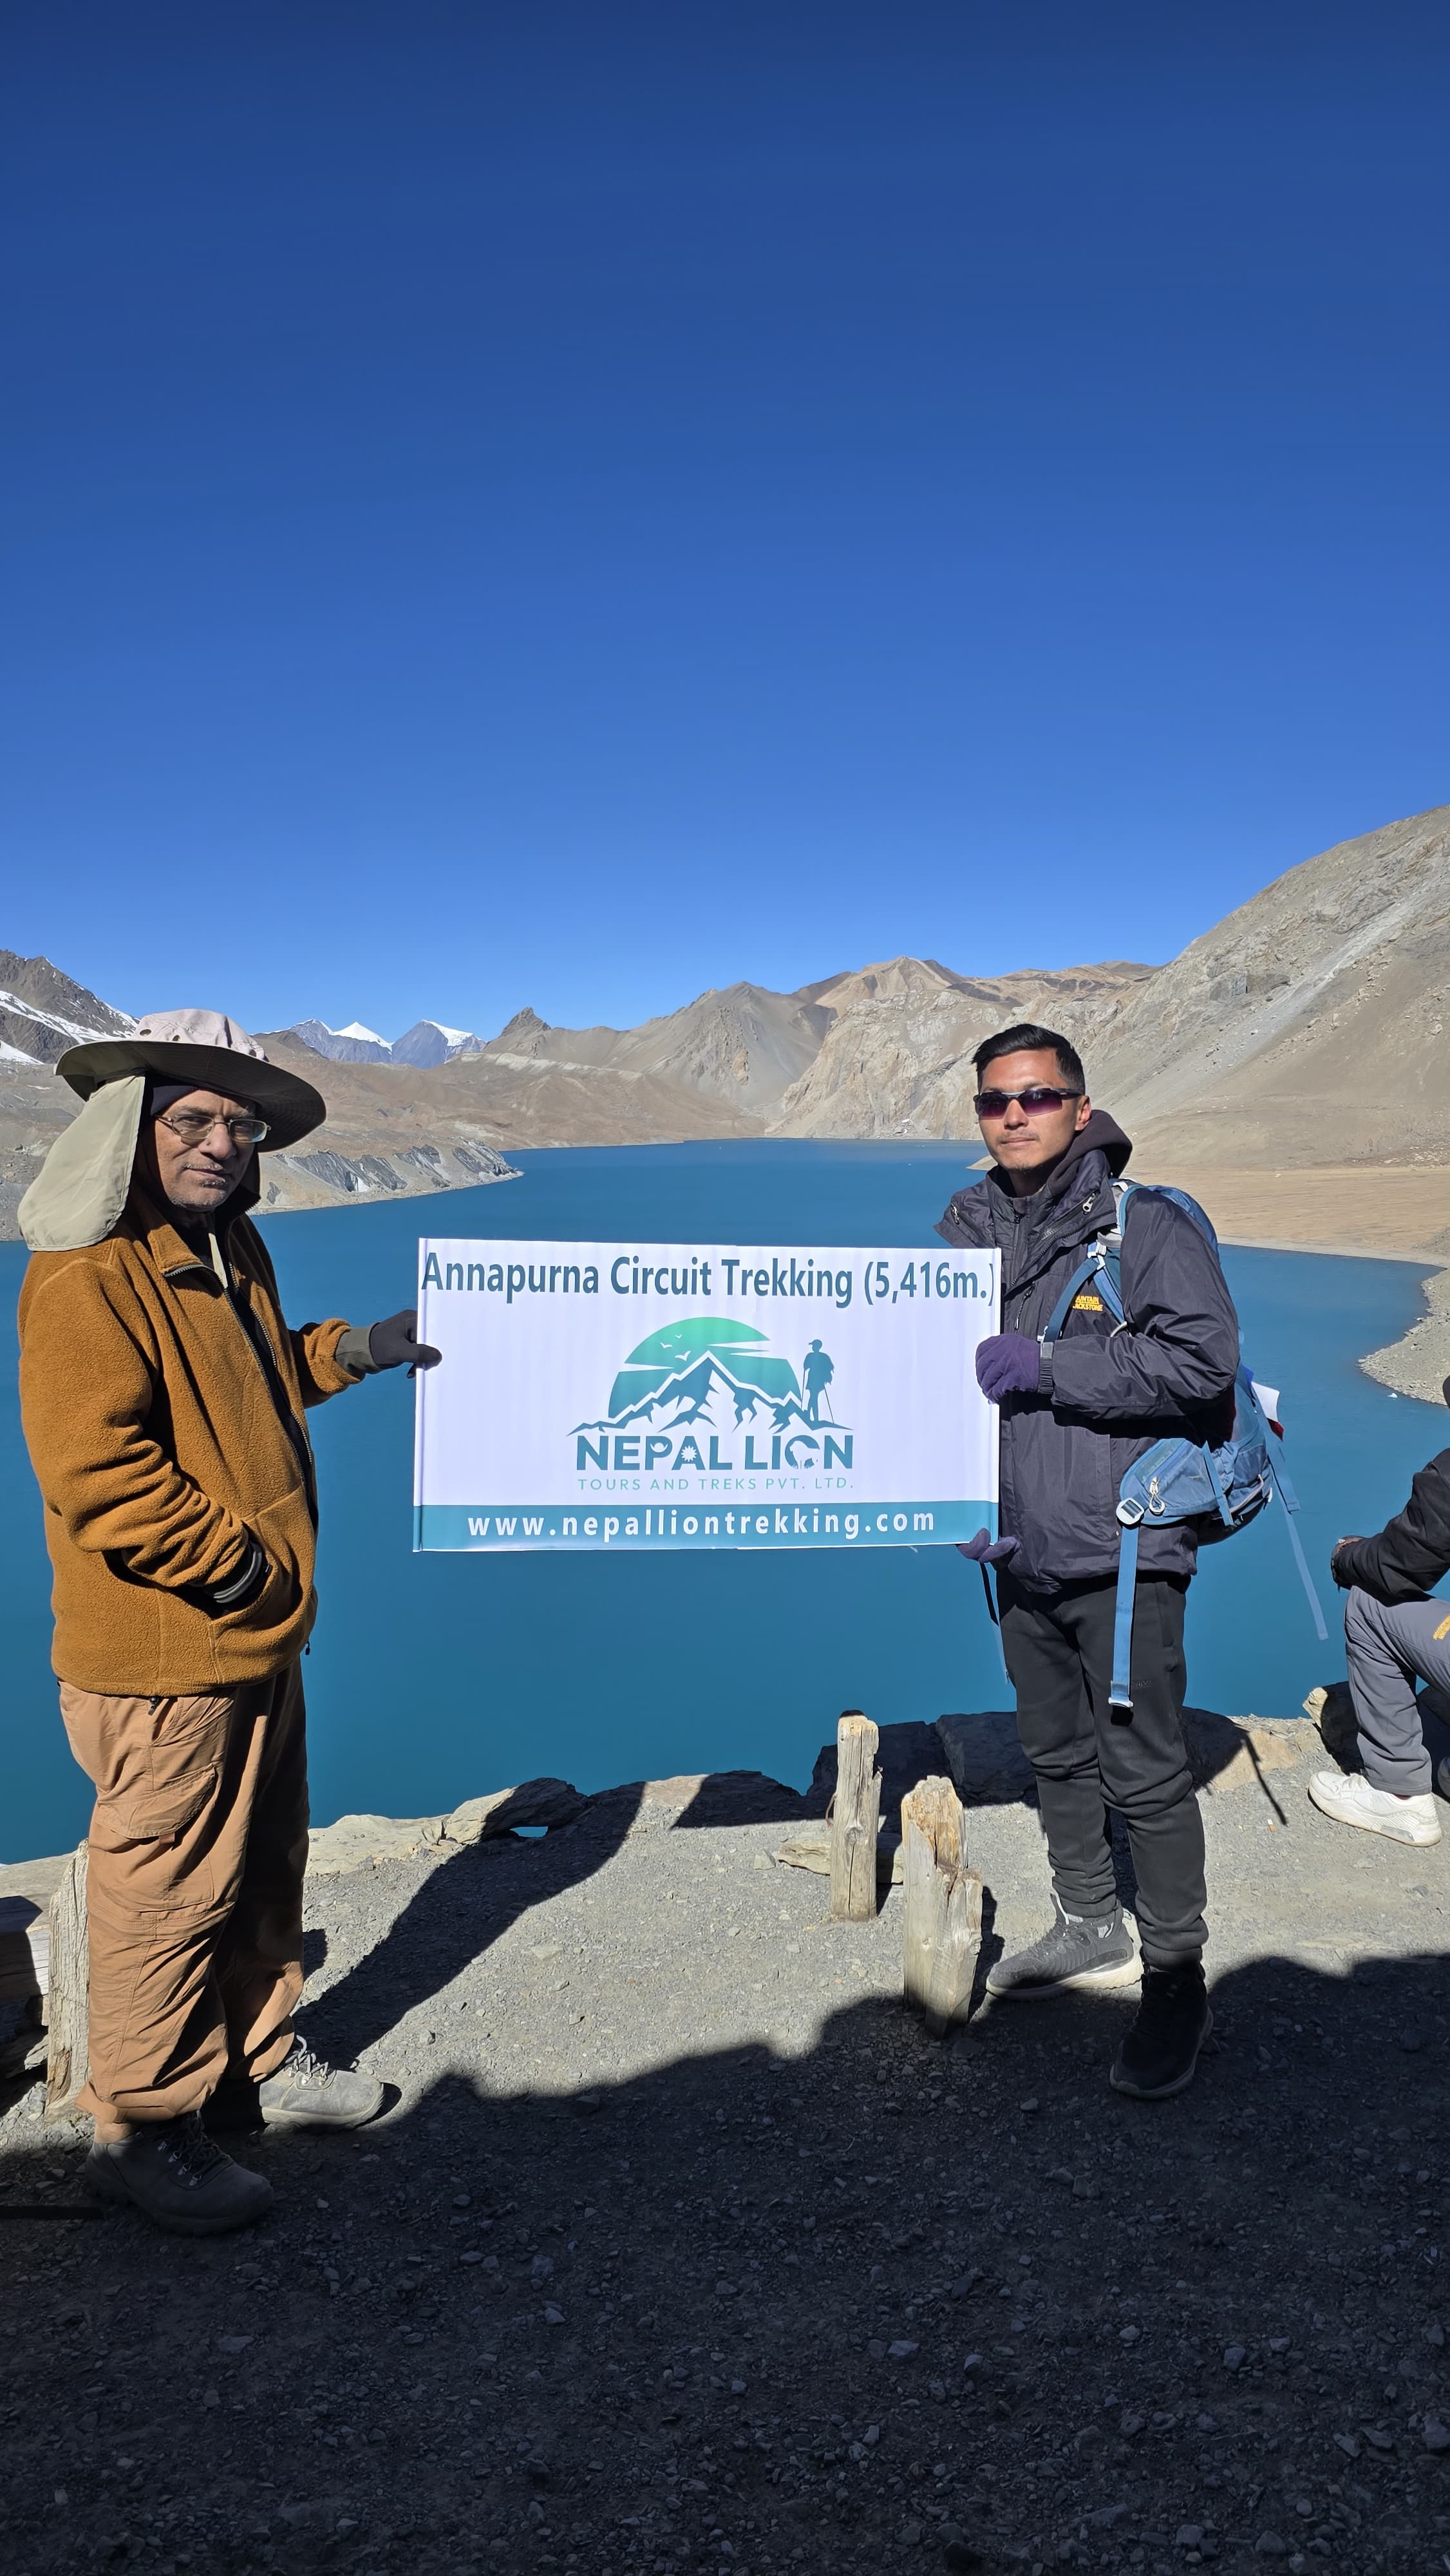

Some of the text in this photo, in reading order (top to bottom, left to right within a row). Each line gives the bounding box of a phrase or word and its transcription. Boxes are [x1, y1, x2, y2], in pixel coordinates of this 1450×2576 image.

[421, 1252, 994, 1309] Annapurna Circuit Trekking (5,416m.)
[576, 1434, 853, 1471] NEPAL LION
[578, 1477, 853, 1491] TOURS AND TREKS PVT. LTD.
[467, 1508, 934, 1543] www.nepalliontrekking.com
